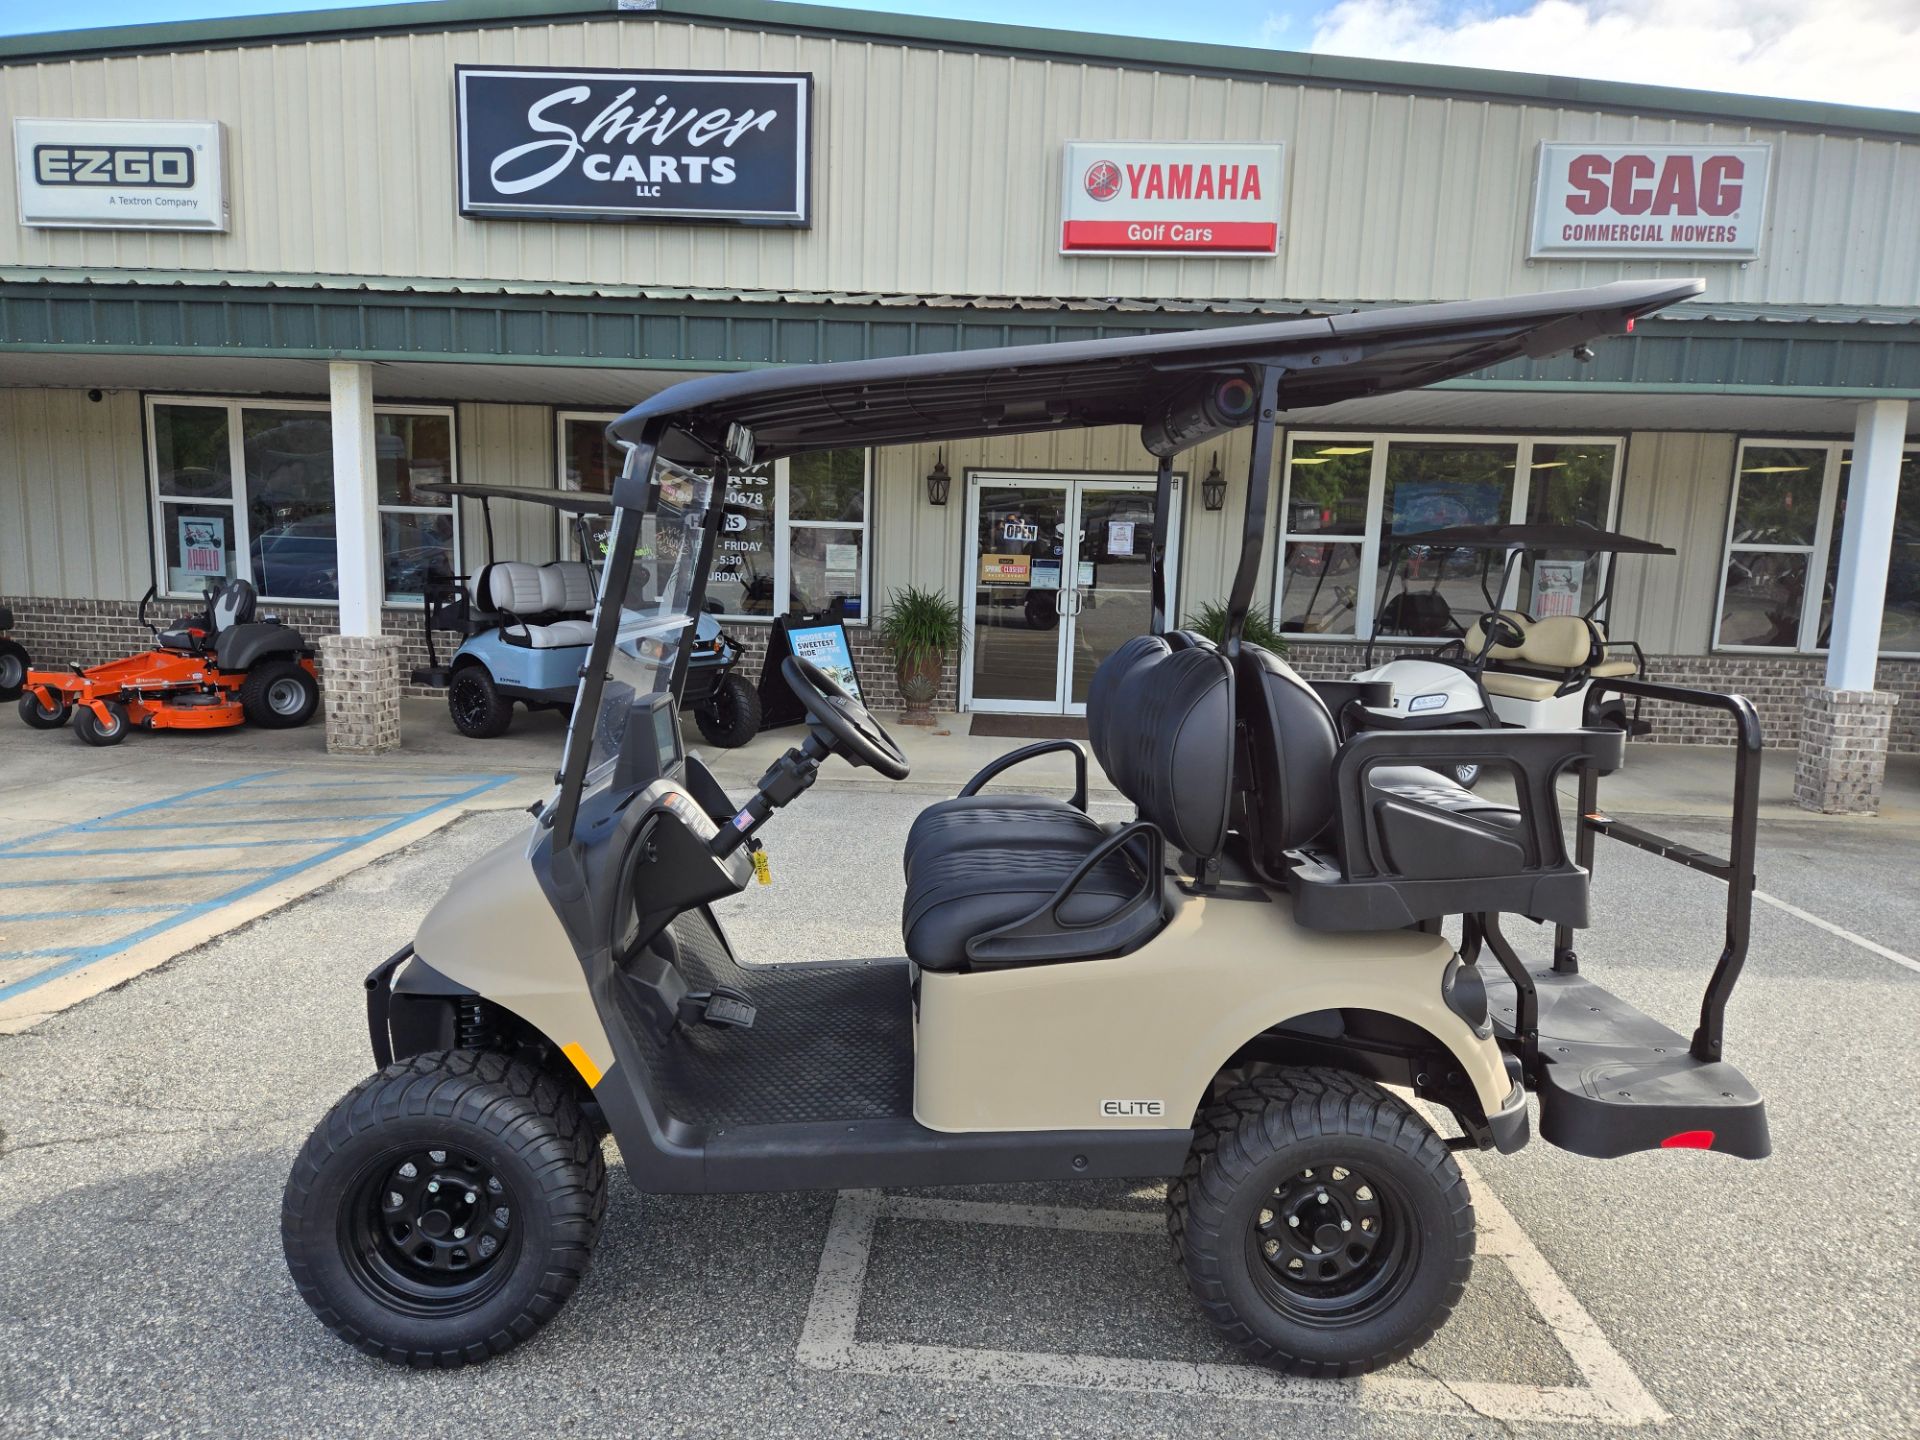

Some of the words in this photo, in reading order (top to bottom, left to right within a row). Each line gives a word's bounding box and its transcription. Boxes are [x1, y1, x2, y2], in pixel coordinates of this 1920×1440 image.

[490, 85, 777, 195] Shiver
[582, 154, 736, 185] CARTS
[1126, 164, 1261, 200] YAMAHA
[1565, 154, 1745, 216] SCAG
[636, 185, 661, 197] LLC
[109, 197, 116, 205] A
[118, 197, 152, 206] Textron
[154, 197, 198, 208] Company
[1127, 224, 1165, 241] Golf
[1170, 225, 1213, 241] Cars
[1562, 224, 1664, 241] COMMERCIAL
[1670, 225, 1737, 242] MOWERS
[1006, 525, 1035, 540] OPEN
[724, 541, 762, 551] FRIDAY
[719, 556, 742, 565] 5:30
[797, 640, 834, 649] SWEETEST
